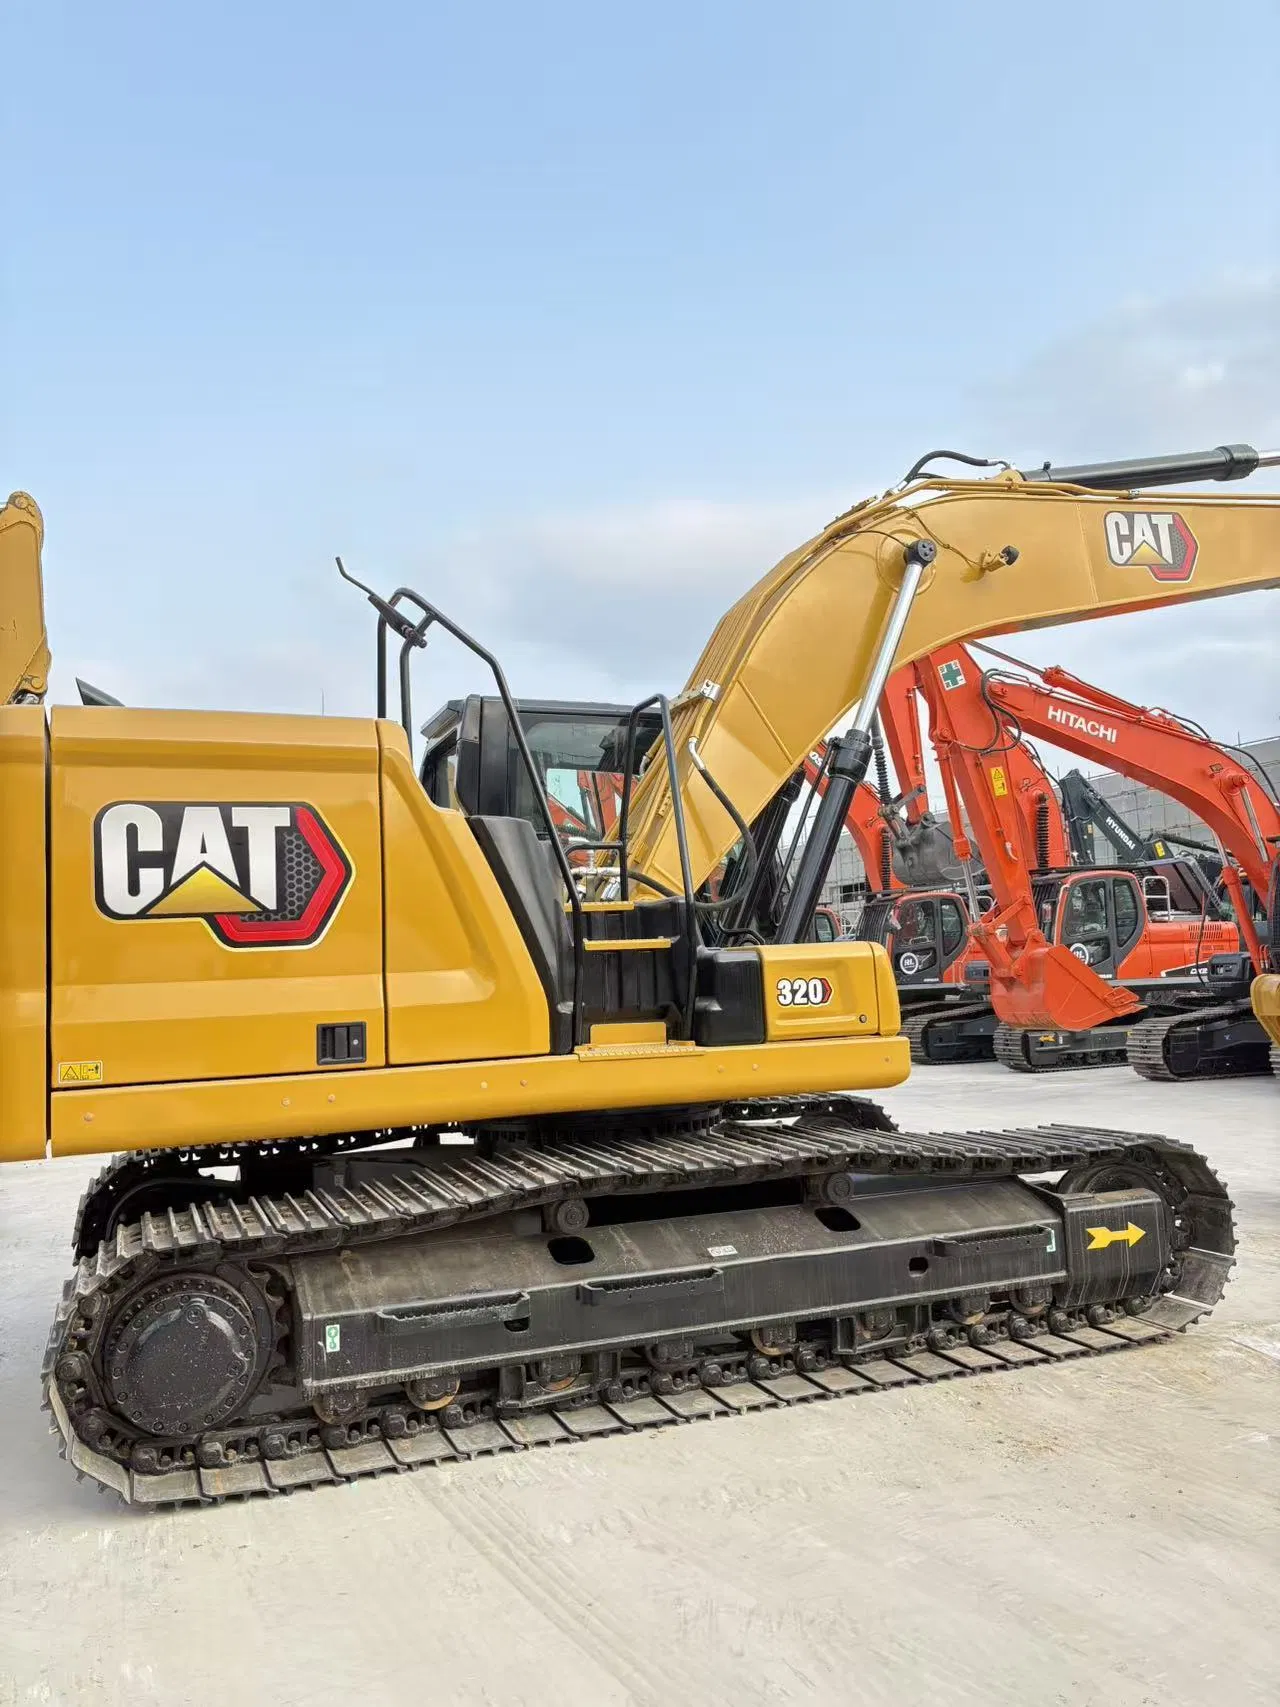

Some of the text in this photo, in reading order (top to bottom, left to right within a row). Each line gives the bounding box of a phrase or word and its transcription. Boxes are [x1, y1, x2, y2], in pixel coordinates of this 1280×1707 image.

[1105, 512, 1174, 564] CAT
[1048, 705, 1117, 743] HITACHI
[1106, 816, 1136, 850] HYUNDAI
[101, 804, 290, 914] CAT
[777, 977, 823, 1006] 320
